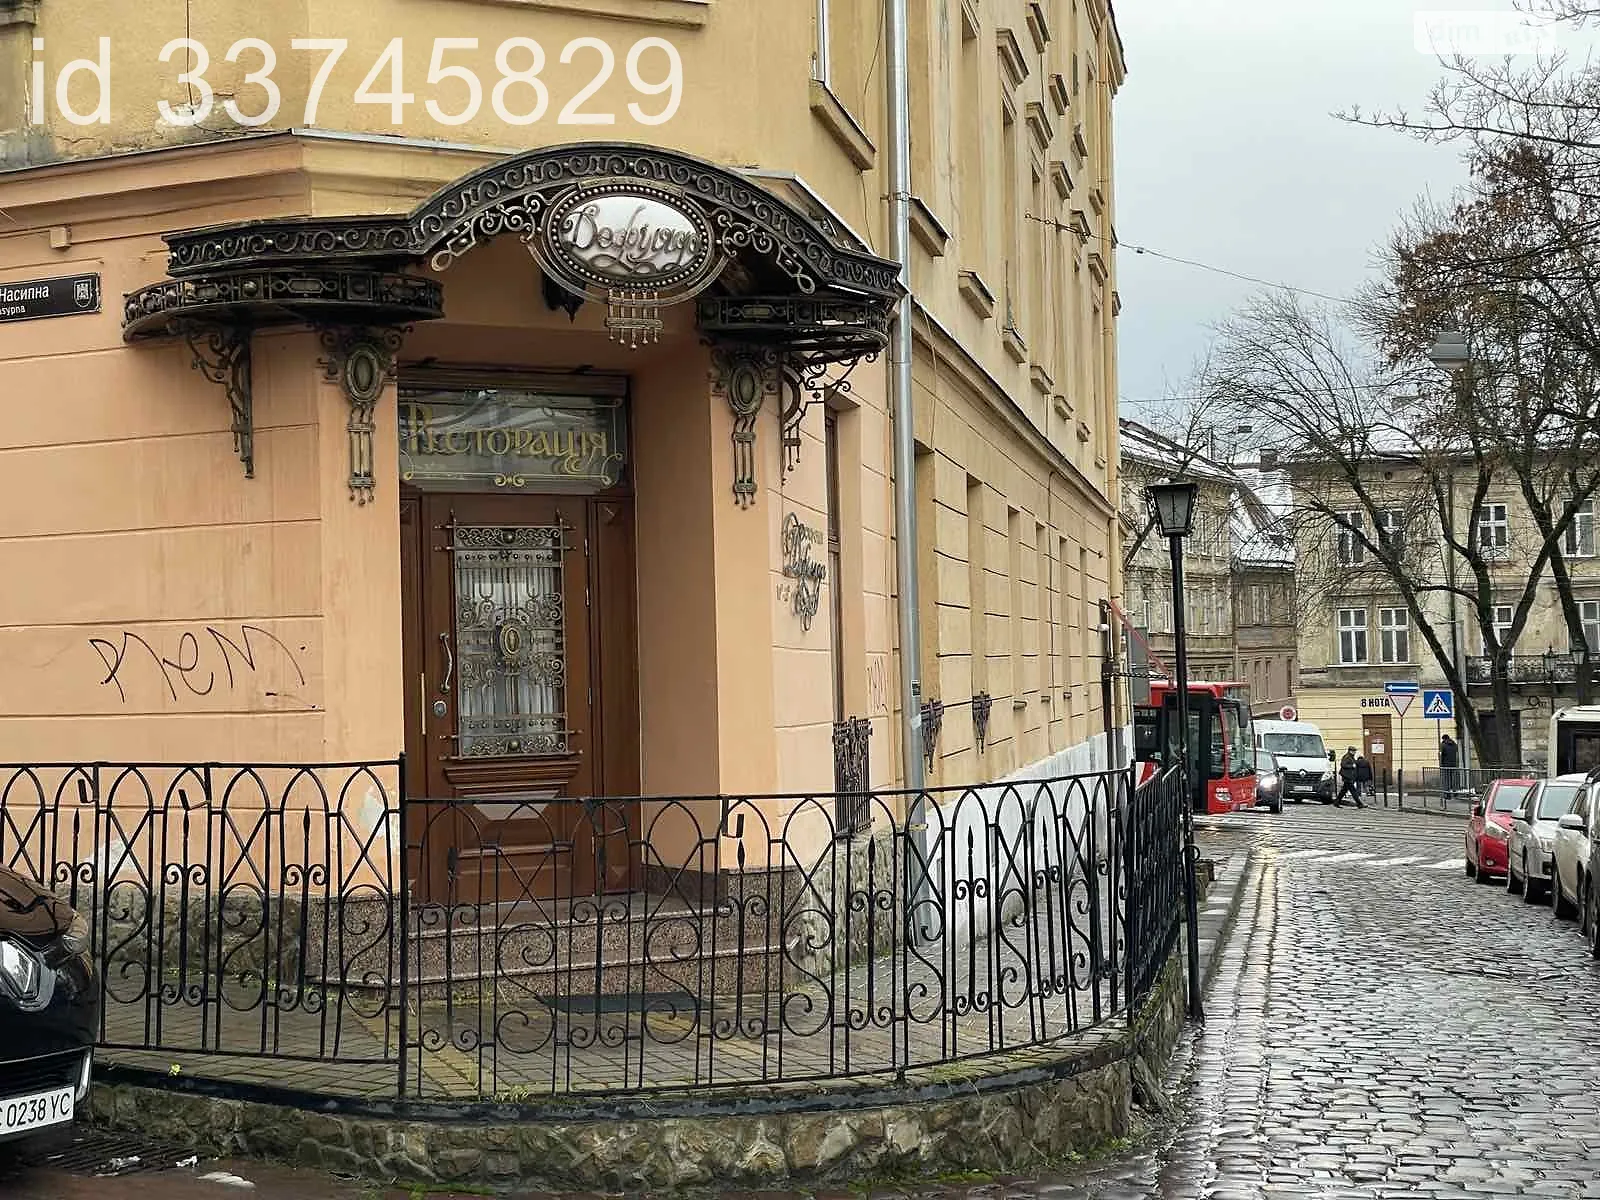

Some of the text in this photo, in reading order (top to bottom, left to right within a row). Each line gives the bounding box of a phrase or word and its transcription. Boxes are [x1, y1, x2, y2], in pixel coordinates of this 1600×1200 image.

[0, 286, 50, 302] Насипна
[0, 305, 26, 316] sypna
[6, 1097, 47, 1128] 0238
